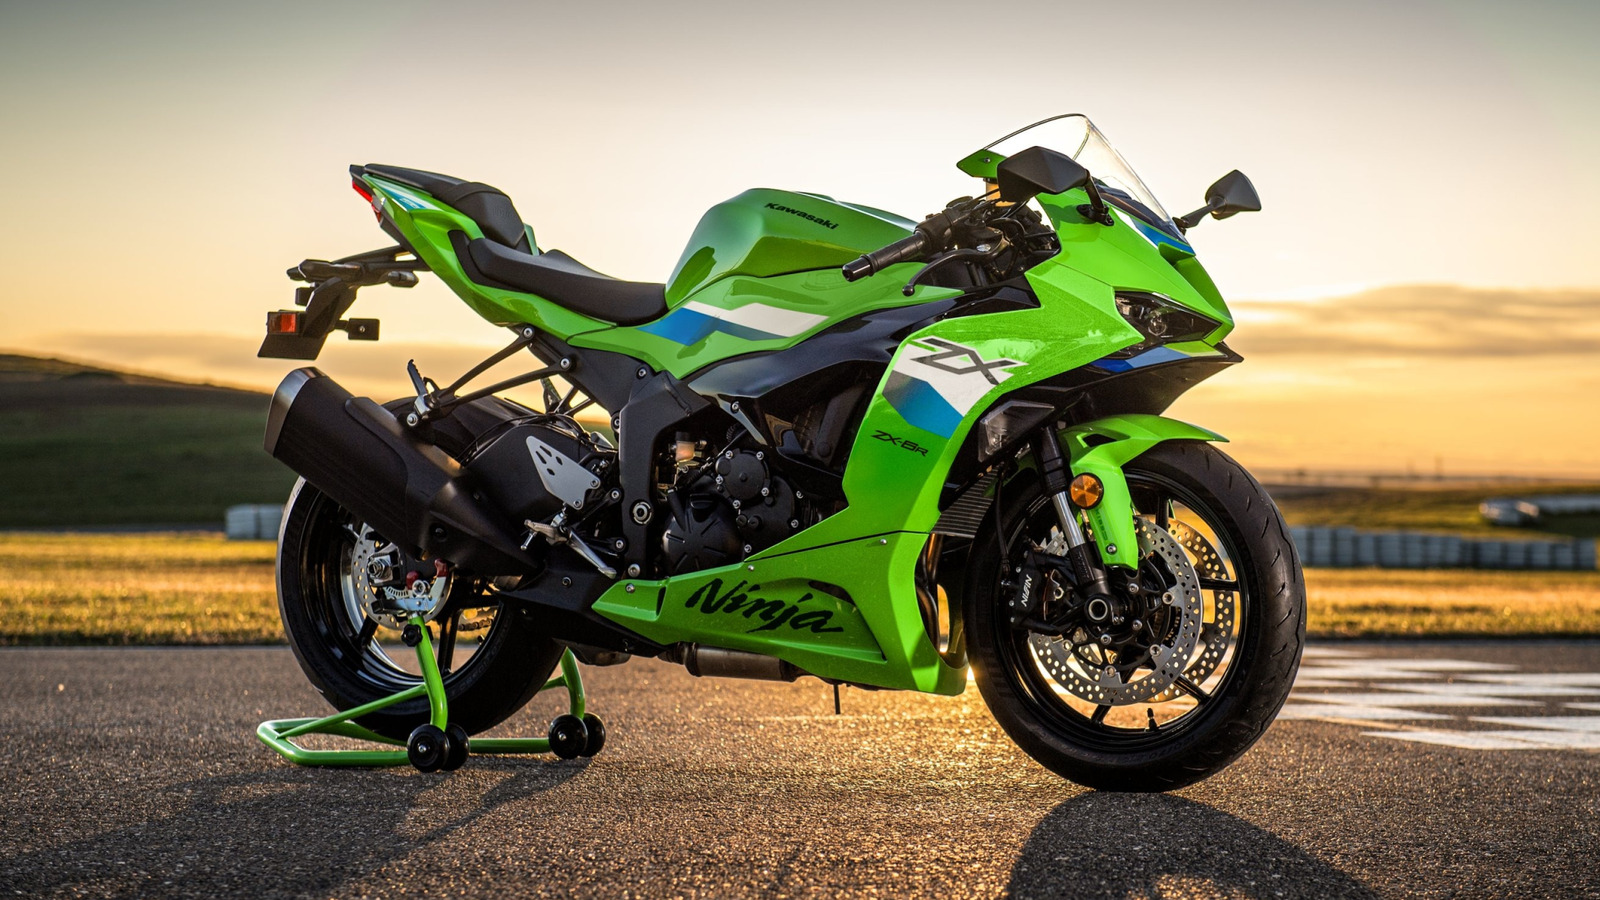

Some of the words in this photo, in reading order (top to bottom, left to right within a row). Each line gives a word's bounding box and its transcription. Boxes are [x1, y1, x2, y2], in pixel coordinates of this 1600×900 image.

[765, 202, 839, 229] Kawasaki
[910, 337, 1018, 386] ZX
[871, 430, 929, 457] ZX-6R
[685, 578, 844, 633] Ninja
